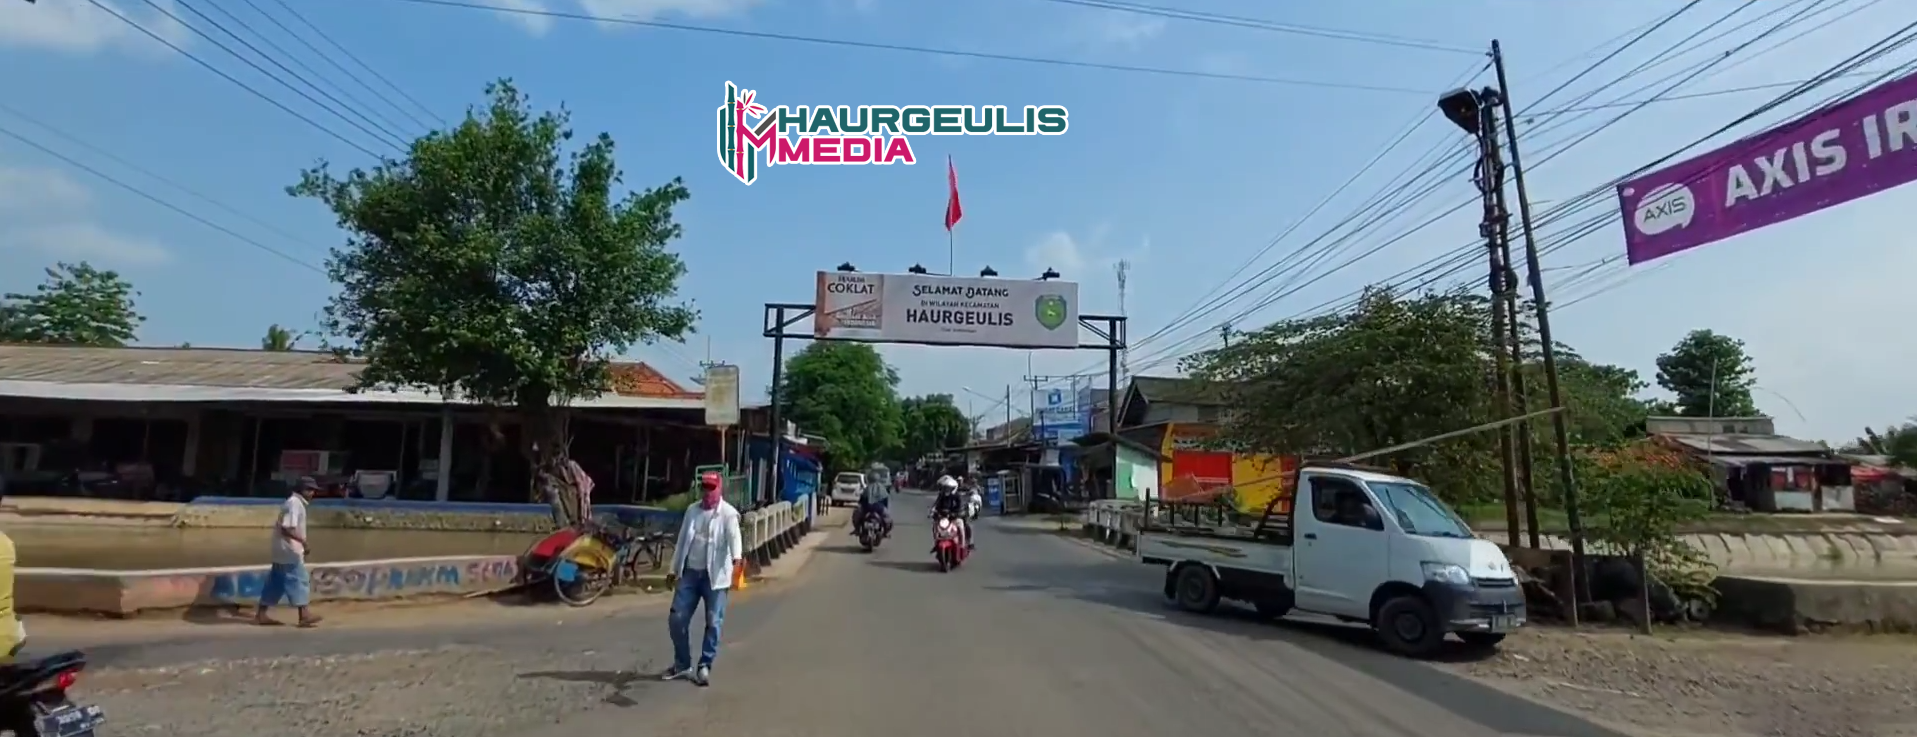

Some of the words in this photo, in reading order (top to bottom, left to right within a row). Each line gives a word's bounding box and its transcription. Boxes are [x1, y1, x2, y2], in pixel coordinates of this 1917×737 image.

[1725, 128, 1848, 208] AXIS
[1642, 195, 1687, 223] AXIS
[827, 282, 875, 295] COKLAT
[912, 284, 963, 297] SELAMAT
[965, 286, 1010, 299] DATANG
[929, 301, 960, 309] WILAYAH
[960, 302, 1000, 310] KECAMATAN
[906, 308, 1014, 327] HAURGEULIS
